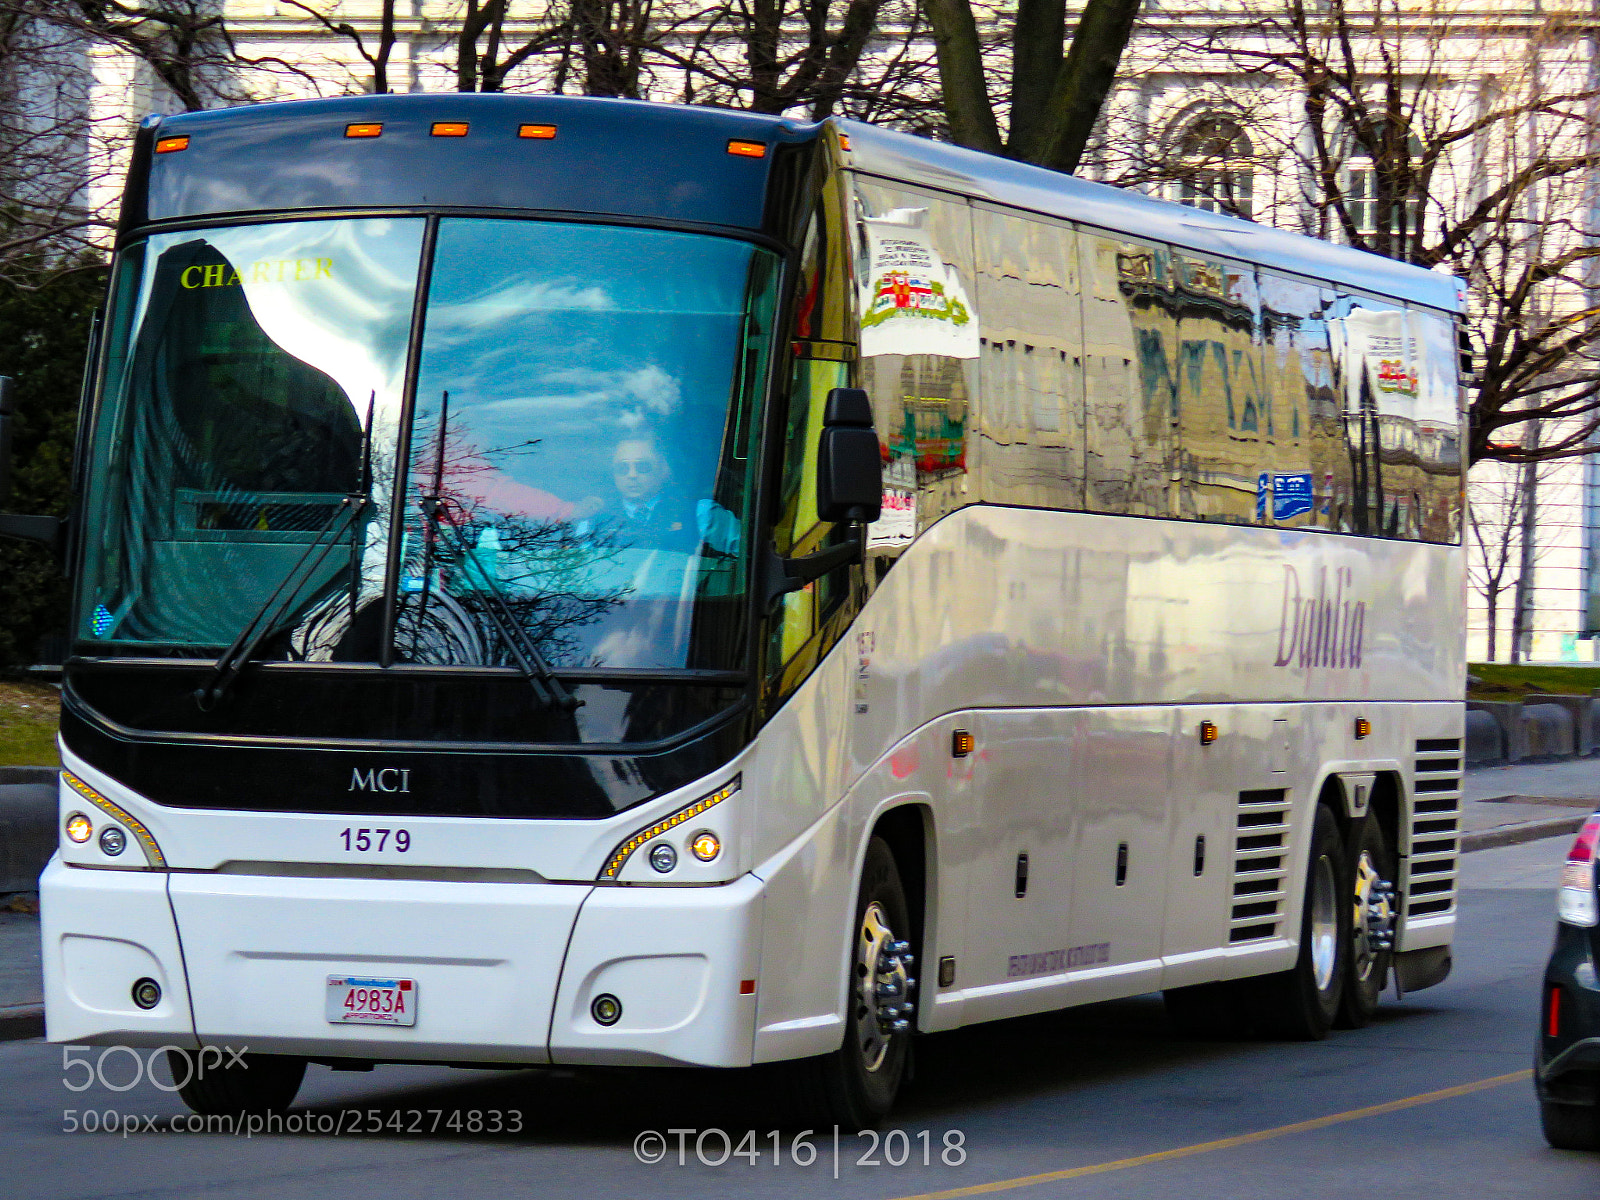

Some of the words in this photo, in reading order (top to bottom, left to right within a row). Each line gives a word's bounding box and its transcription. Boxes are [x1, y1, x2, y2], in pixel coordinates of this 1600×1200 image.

[180, 257, 334, 289] CHARTER
[348, 767, 411, 793] MCI
[340, 827, 411, 853] 1579
[344, 988, 405, 1014] 4983A
